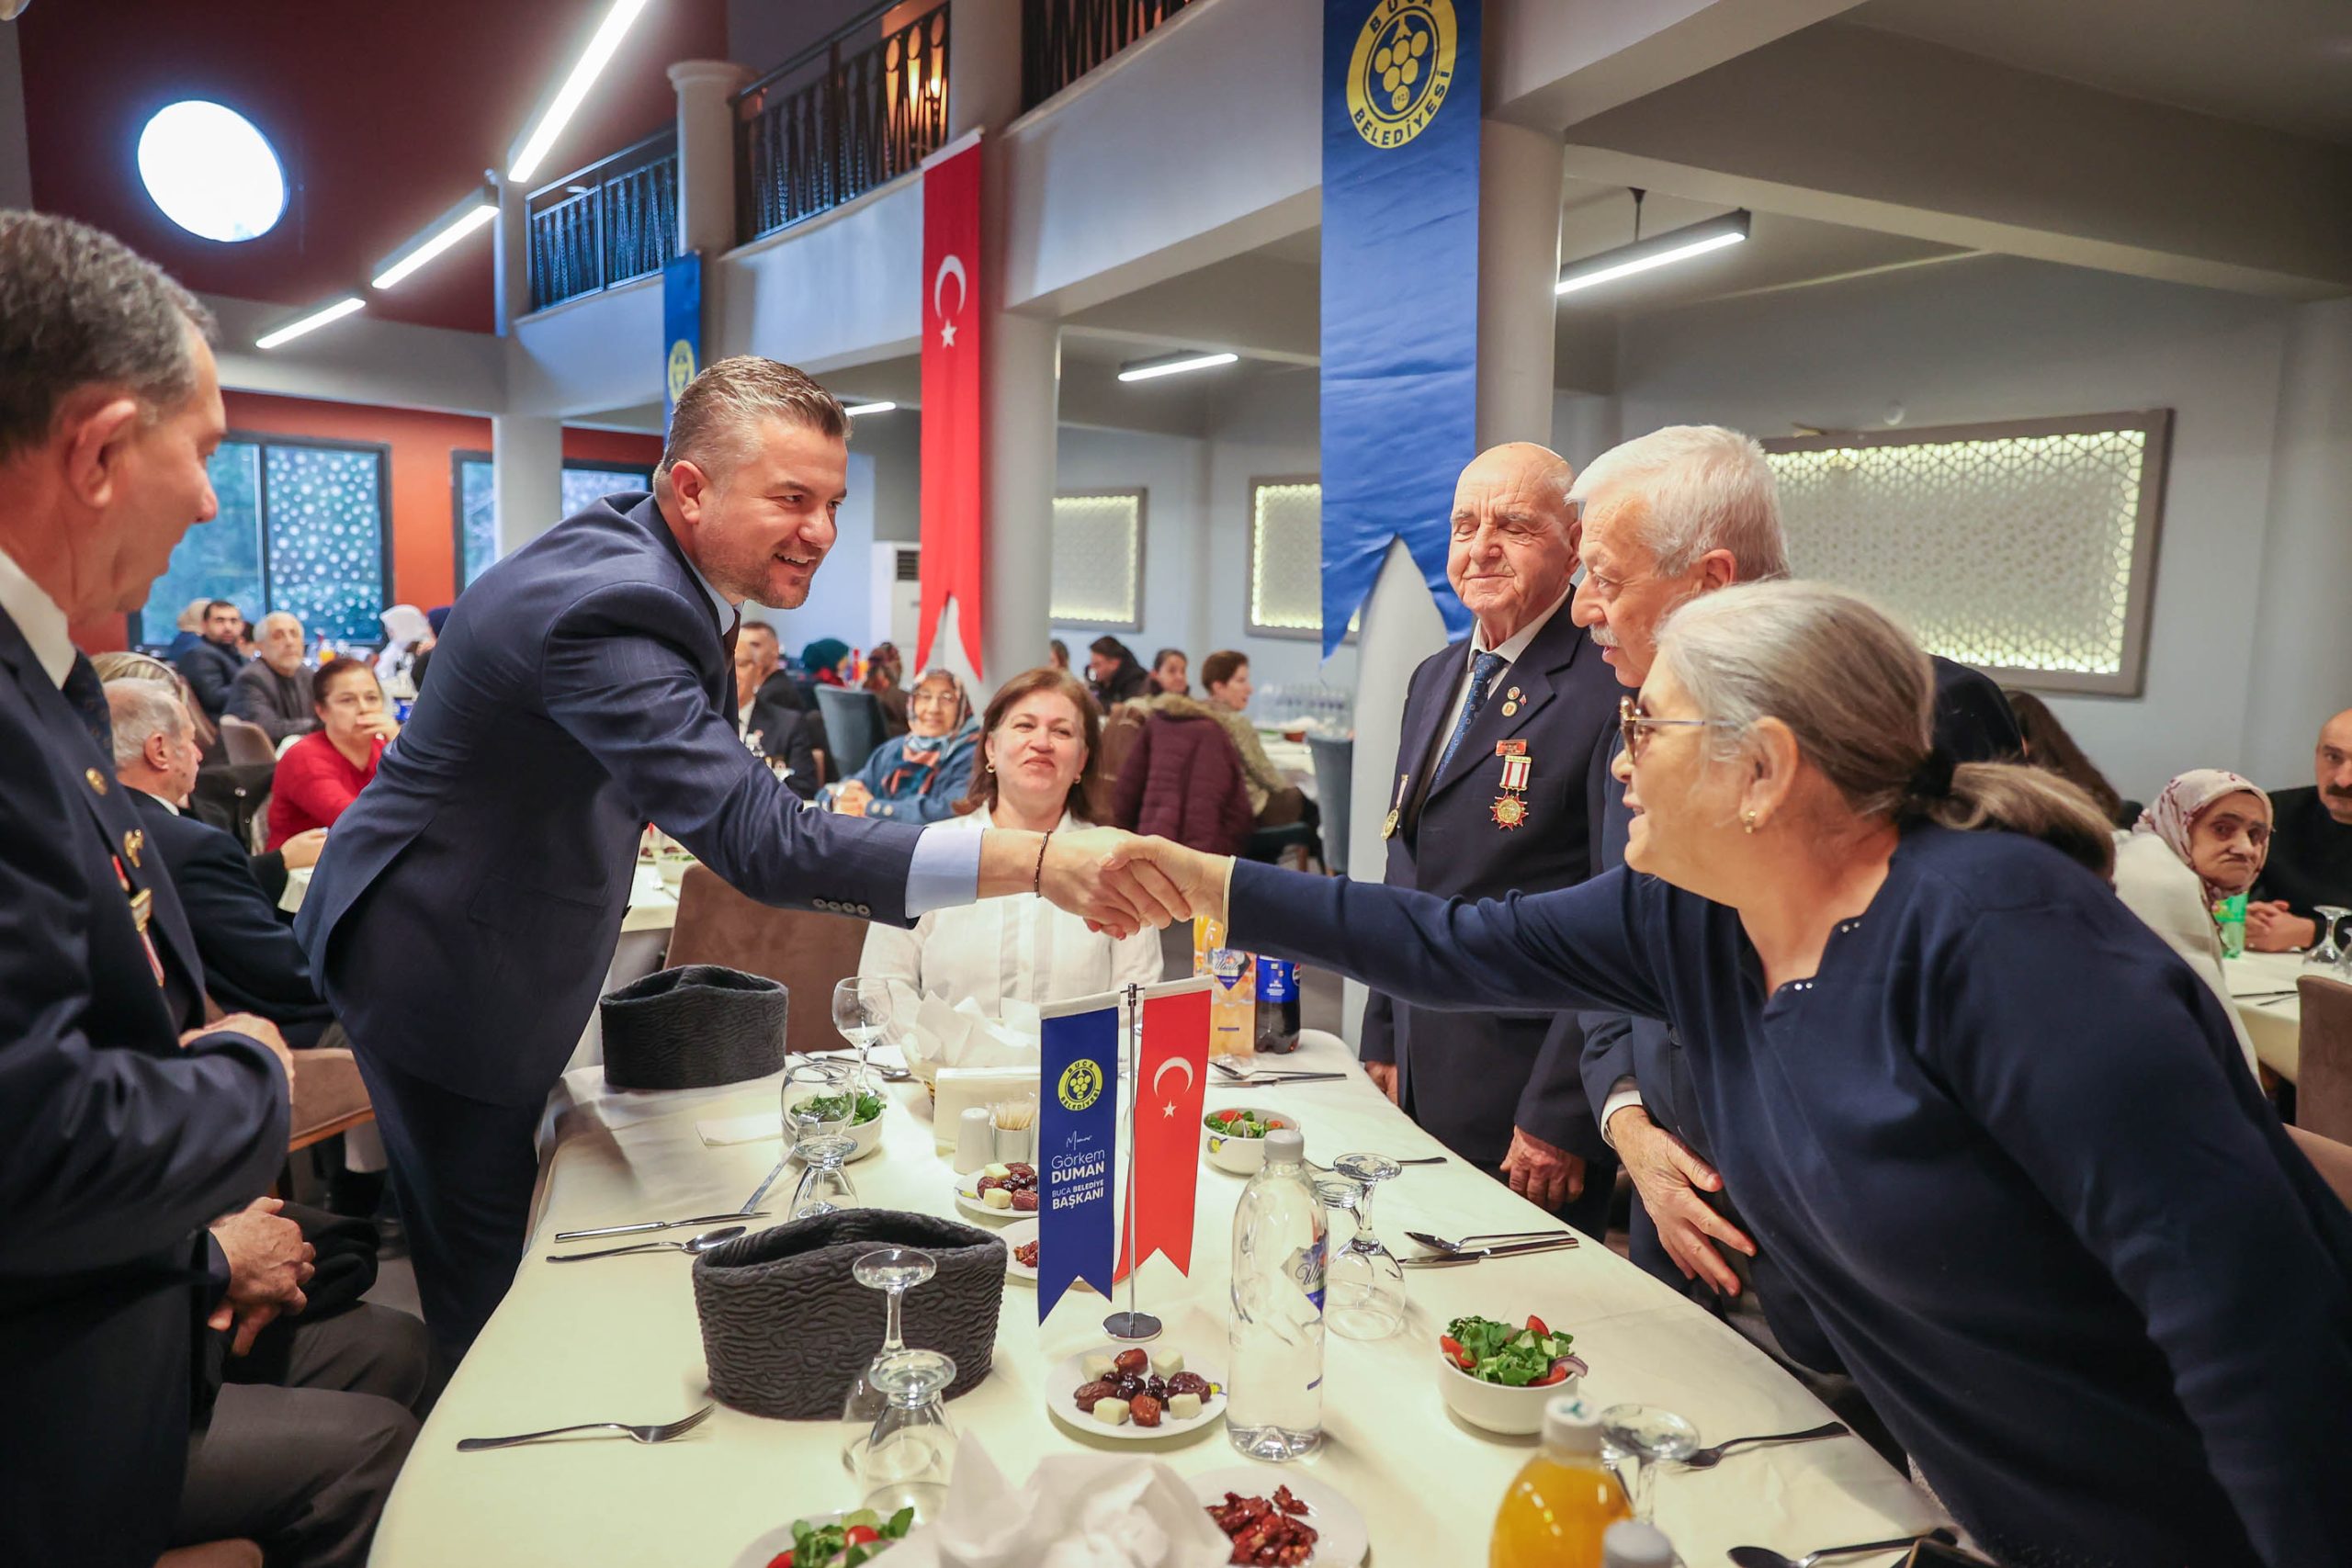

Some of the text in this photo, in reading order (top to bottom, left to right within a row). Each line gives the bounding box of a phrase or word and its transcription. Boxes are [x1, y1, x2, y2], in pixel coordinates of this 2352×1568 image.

[1353, 71, 1451, 146] BELEDİYESİ
[1068, 1060, 1094, 1074] BUCA
[1051, 1149, 1105, 1169] Görkem
[1051, 1160, 1104, 1184] DUMAN
[1051, 1179, 1104, 1198] BUCA BELEDİYE
[1052, 1187, 1104, 1210] BAŞKANI
